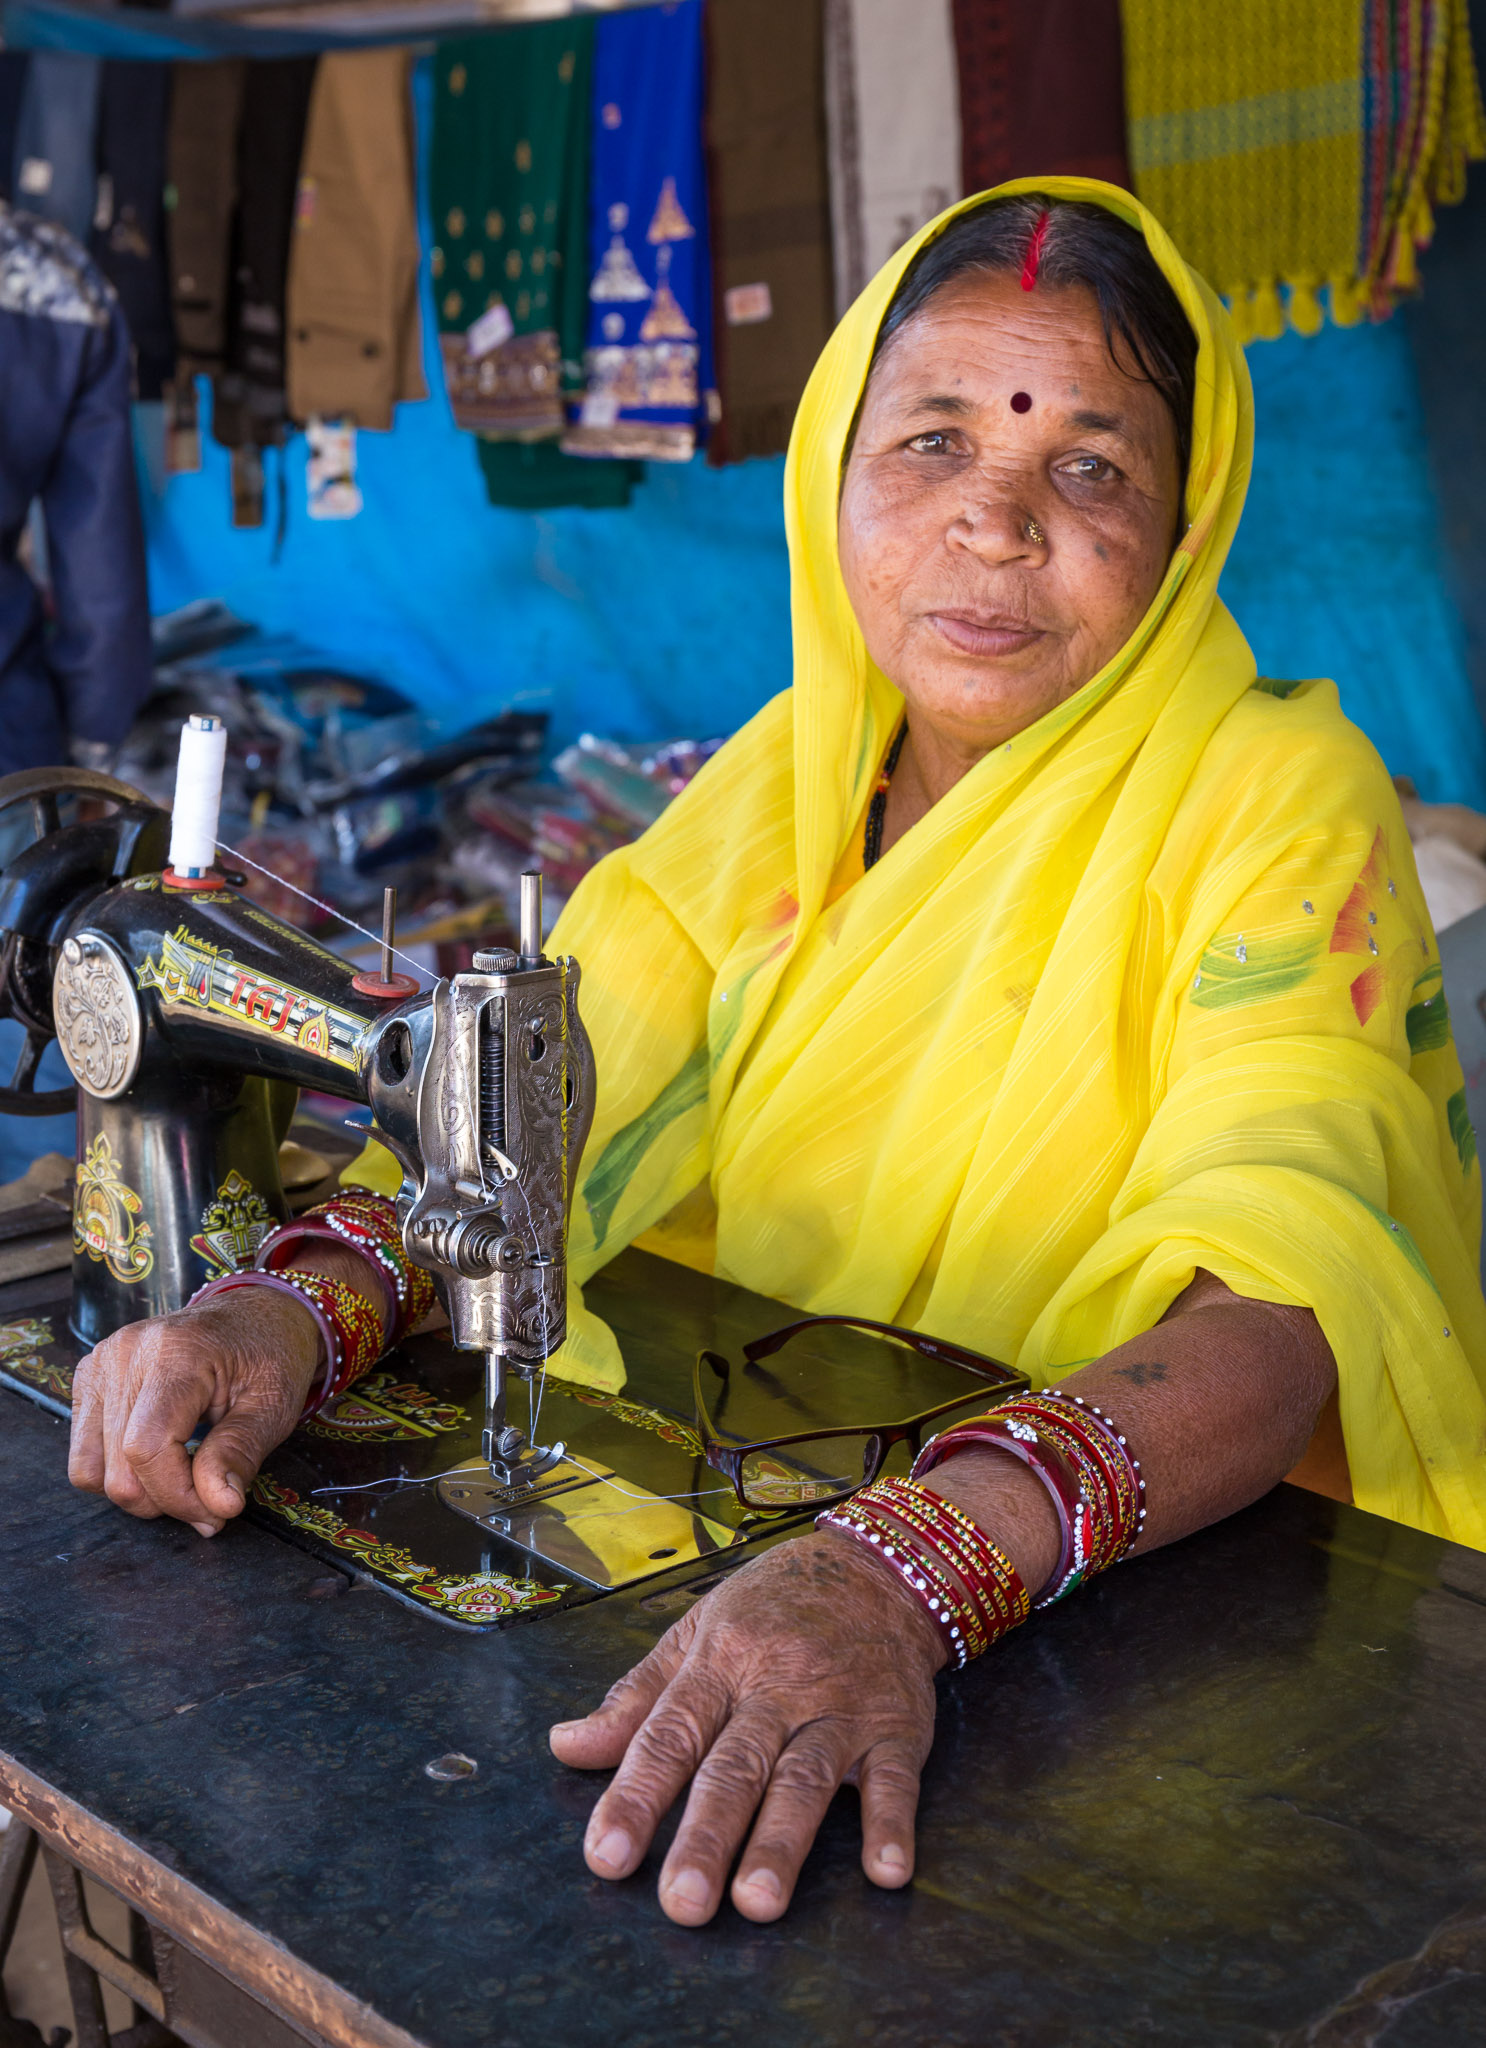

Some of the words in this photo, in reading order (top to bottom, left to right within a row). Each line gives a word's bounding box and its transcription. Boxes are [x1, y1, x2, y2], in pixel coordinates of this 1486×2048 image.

[230, 970, 299, 1033] TAJ
[88, 1230, 105, 1249] TAJ
[462, 1605, 502, 1613] TAJ
